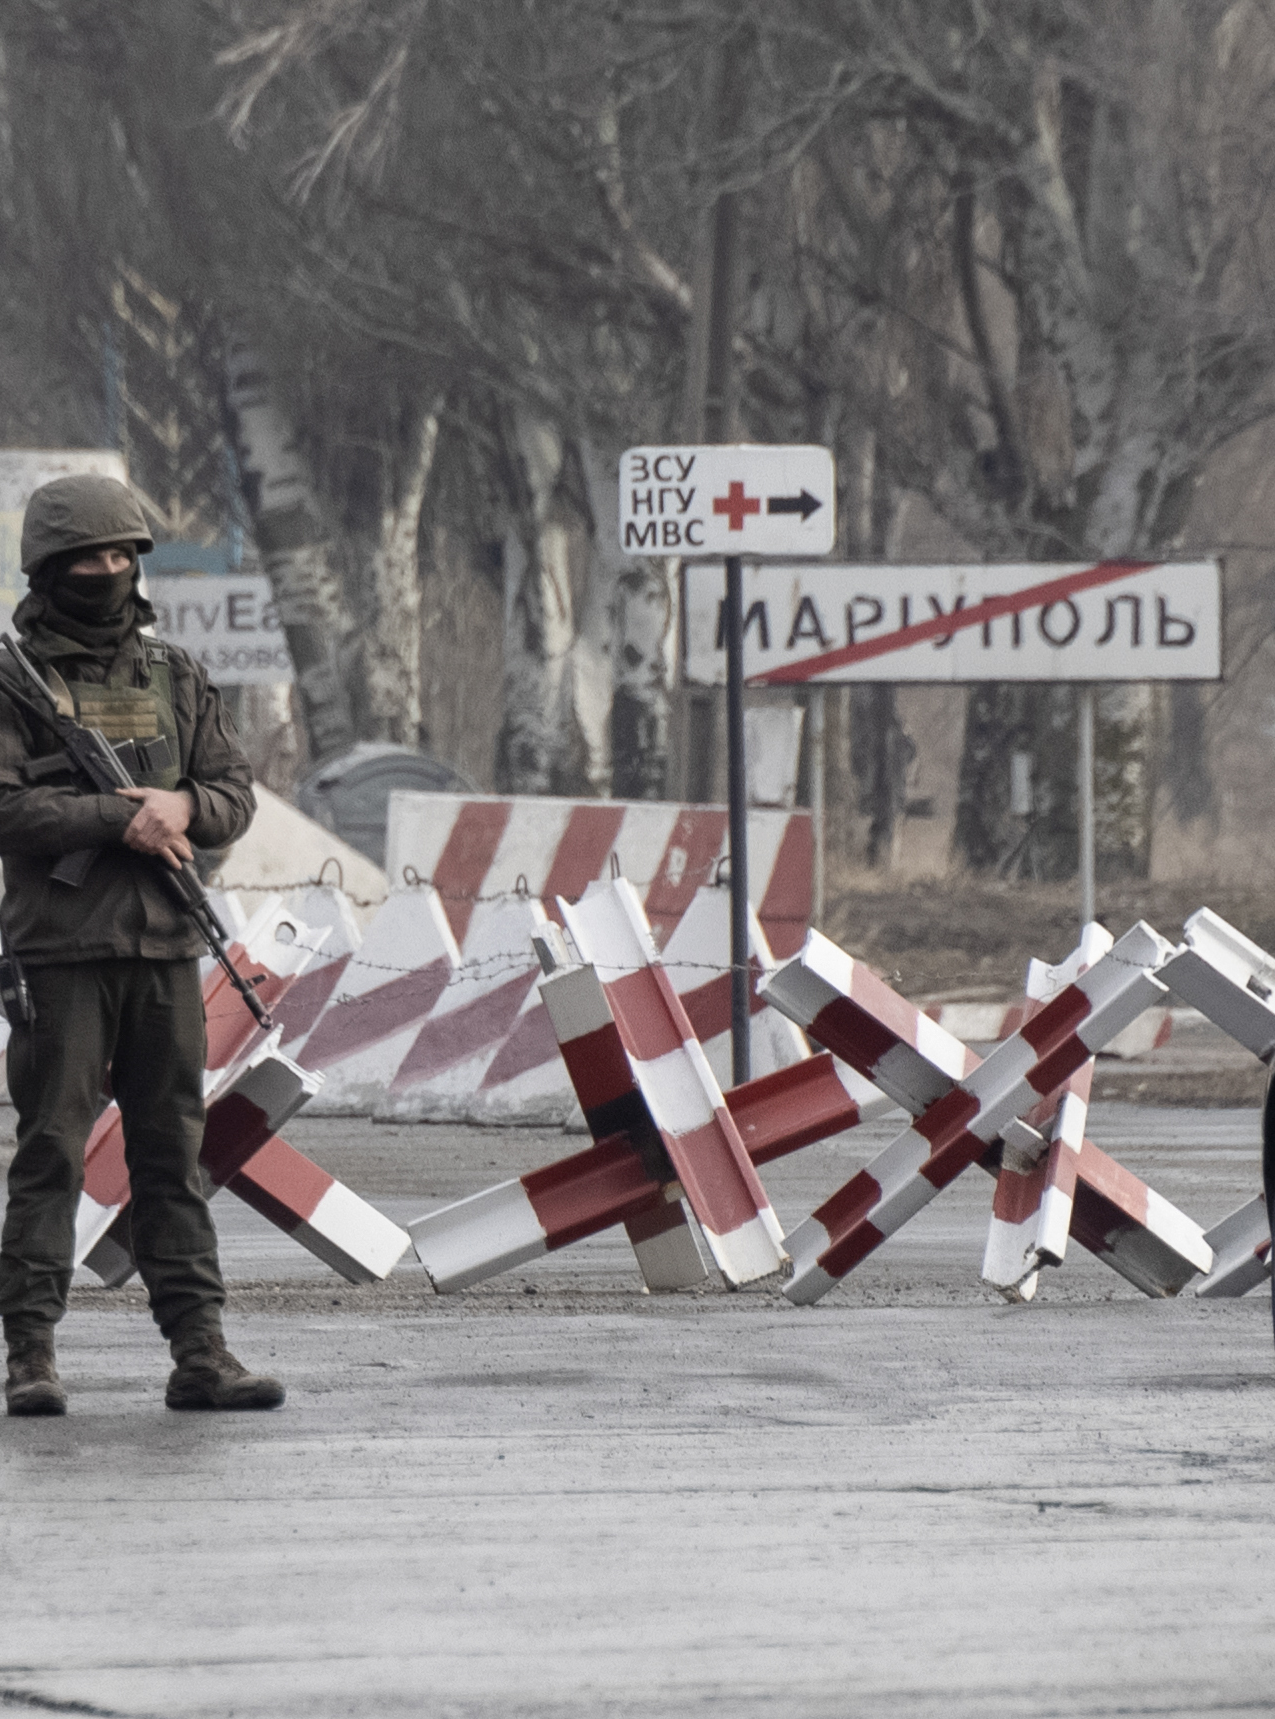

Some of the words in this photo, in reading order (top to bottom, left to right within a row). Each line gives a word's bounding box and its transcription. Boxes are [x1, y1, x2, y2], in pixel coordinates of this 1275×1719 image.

[631, 455, 695, 482] ЗСУ
[632, 487, 695, 515] НГУ
[625, 519, 704, 547] МВС
[154, 592, 281, 634] arvEa
[715, 594, 1196, 649] МАРІУПОЛЬ
